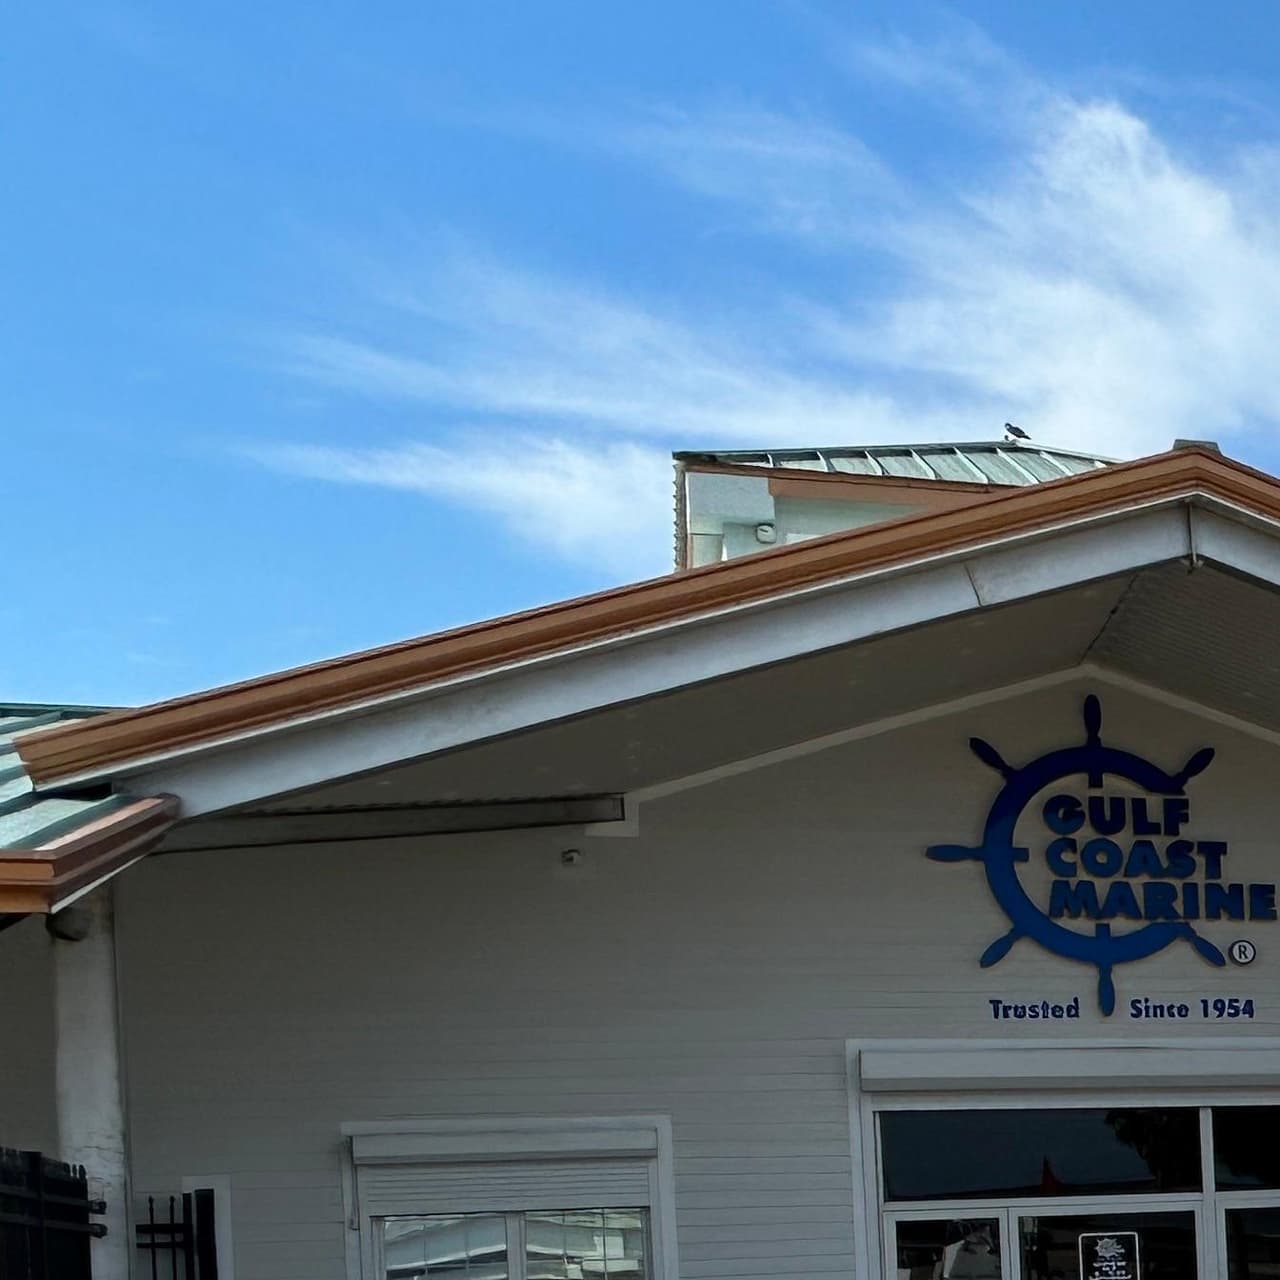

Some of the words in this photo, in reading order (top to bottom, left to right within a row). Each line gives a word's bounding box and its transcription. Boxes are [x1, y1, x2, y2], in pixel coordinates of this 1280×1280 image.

[1042, 794, 1190, 836] GULF
[1045, 837, 1228, 880] COAST
[1048, 879, 1278, 921] MARINE
[989, 996, 1080, 1019] Trusted
[1130, 997, 1189, 1019] Since
[1201, 999, 1254, 1018] 1954
